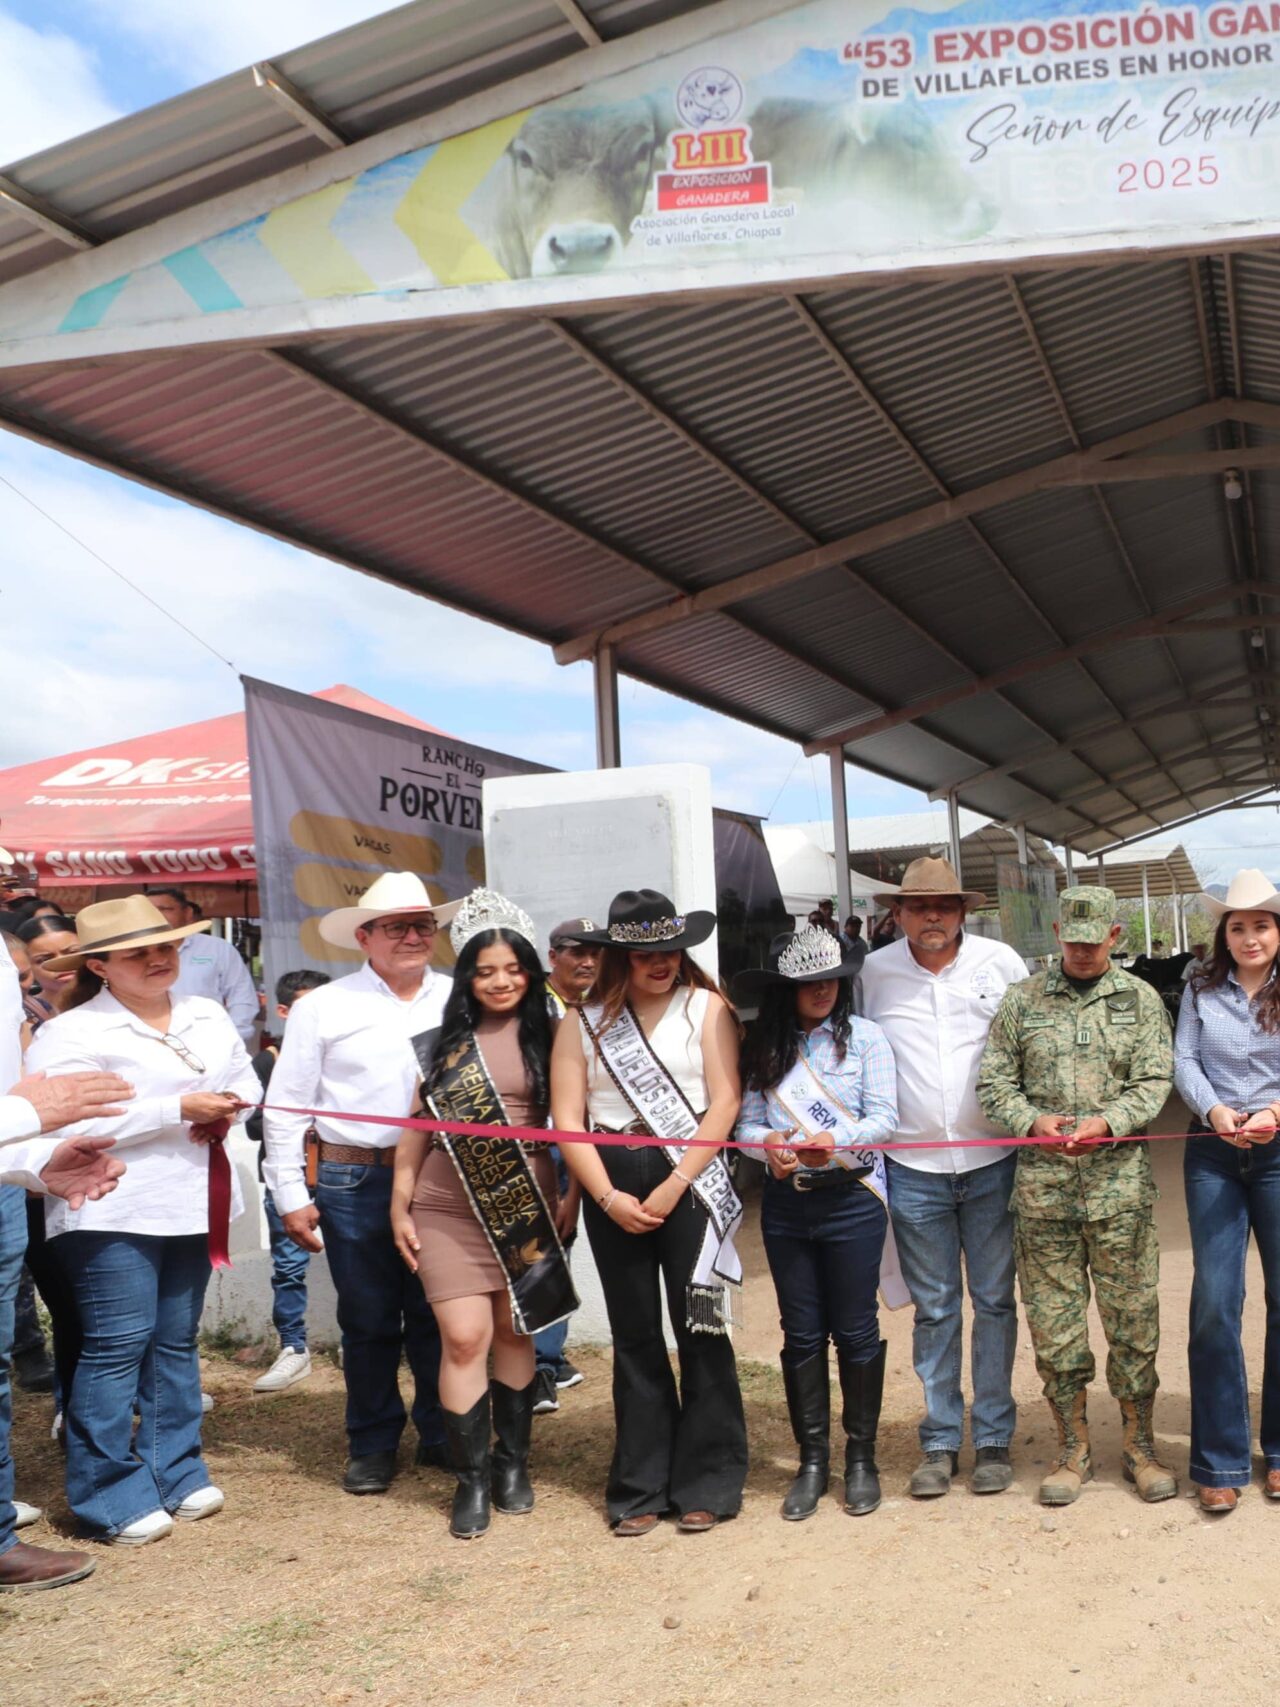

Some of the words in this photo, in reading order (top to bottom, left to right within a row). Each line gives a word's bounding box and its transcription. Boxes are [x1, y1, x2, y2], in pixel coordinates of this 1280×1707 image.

[933, 7, 1195, 63] EXPOSICIÓN
[862, 77, 899, 98] DE
[914, 59, 1110, 95] VILLAFLORES
[1119, 55, 1158, 77] EN
[1168, 41, 1273, 73] HONOR
[965, 103, 1092, 163] Señor
[1096, 99, 1147, 144] de
[672, 128, 748, 170] LIII
[1117, 155, 1220, 193] 2025
[676, 190, 750, 206] GANADERA
[634, 213, 698, 230] Asociación
[701, 210, 760, 225] Ganadera
[762, 205, 795, 219] Local
[646, 234, 662, 247] de
[735, 226, 782, 242] Chiapas
[422, 745, 486, 778] RANCHO
[446, 772, 461, 789] EL
[353, 835, 392, 854] VACAS
[15, 851, 38, 875] Y
[45, 850, 134, 877] SANO
[137, 847, 228, 873] TODO
[580, 919, 594, 932] B
[458, 1062, 494, 1121] REINA
[447, 1078, 503, 1187] VILLALORES
[490, 1185, 522, 1227] 2025
[495, 1147, 518, 1175] LA
[506, 1174, 540, 1226] FERIA
